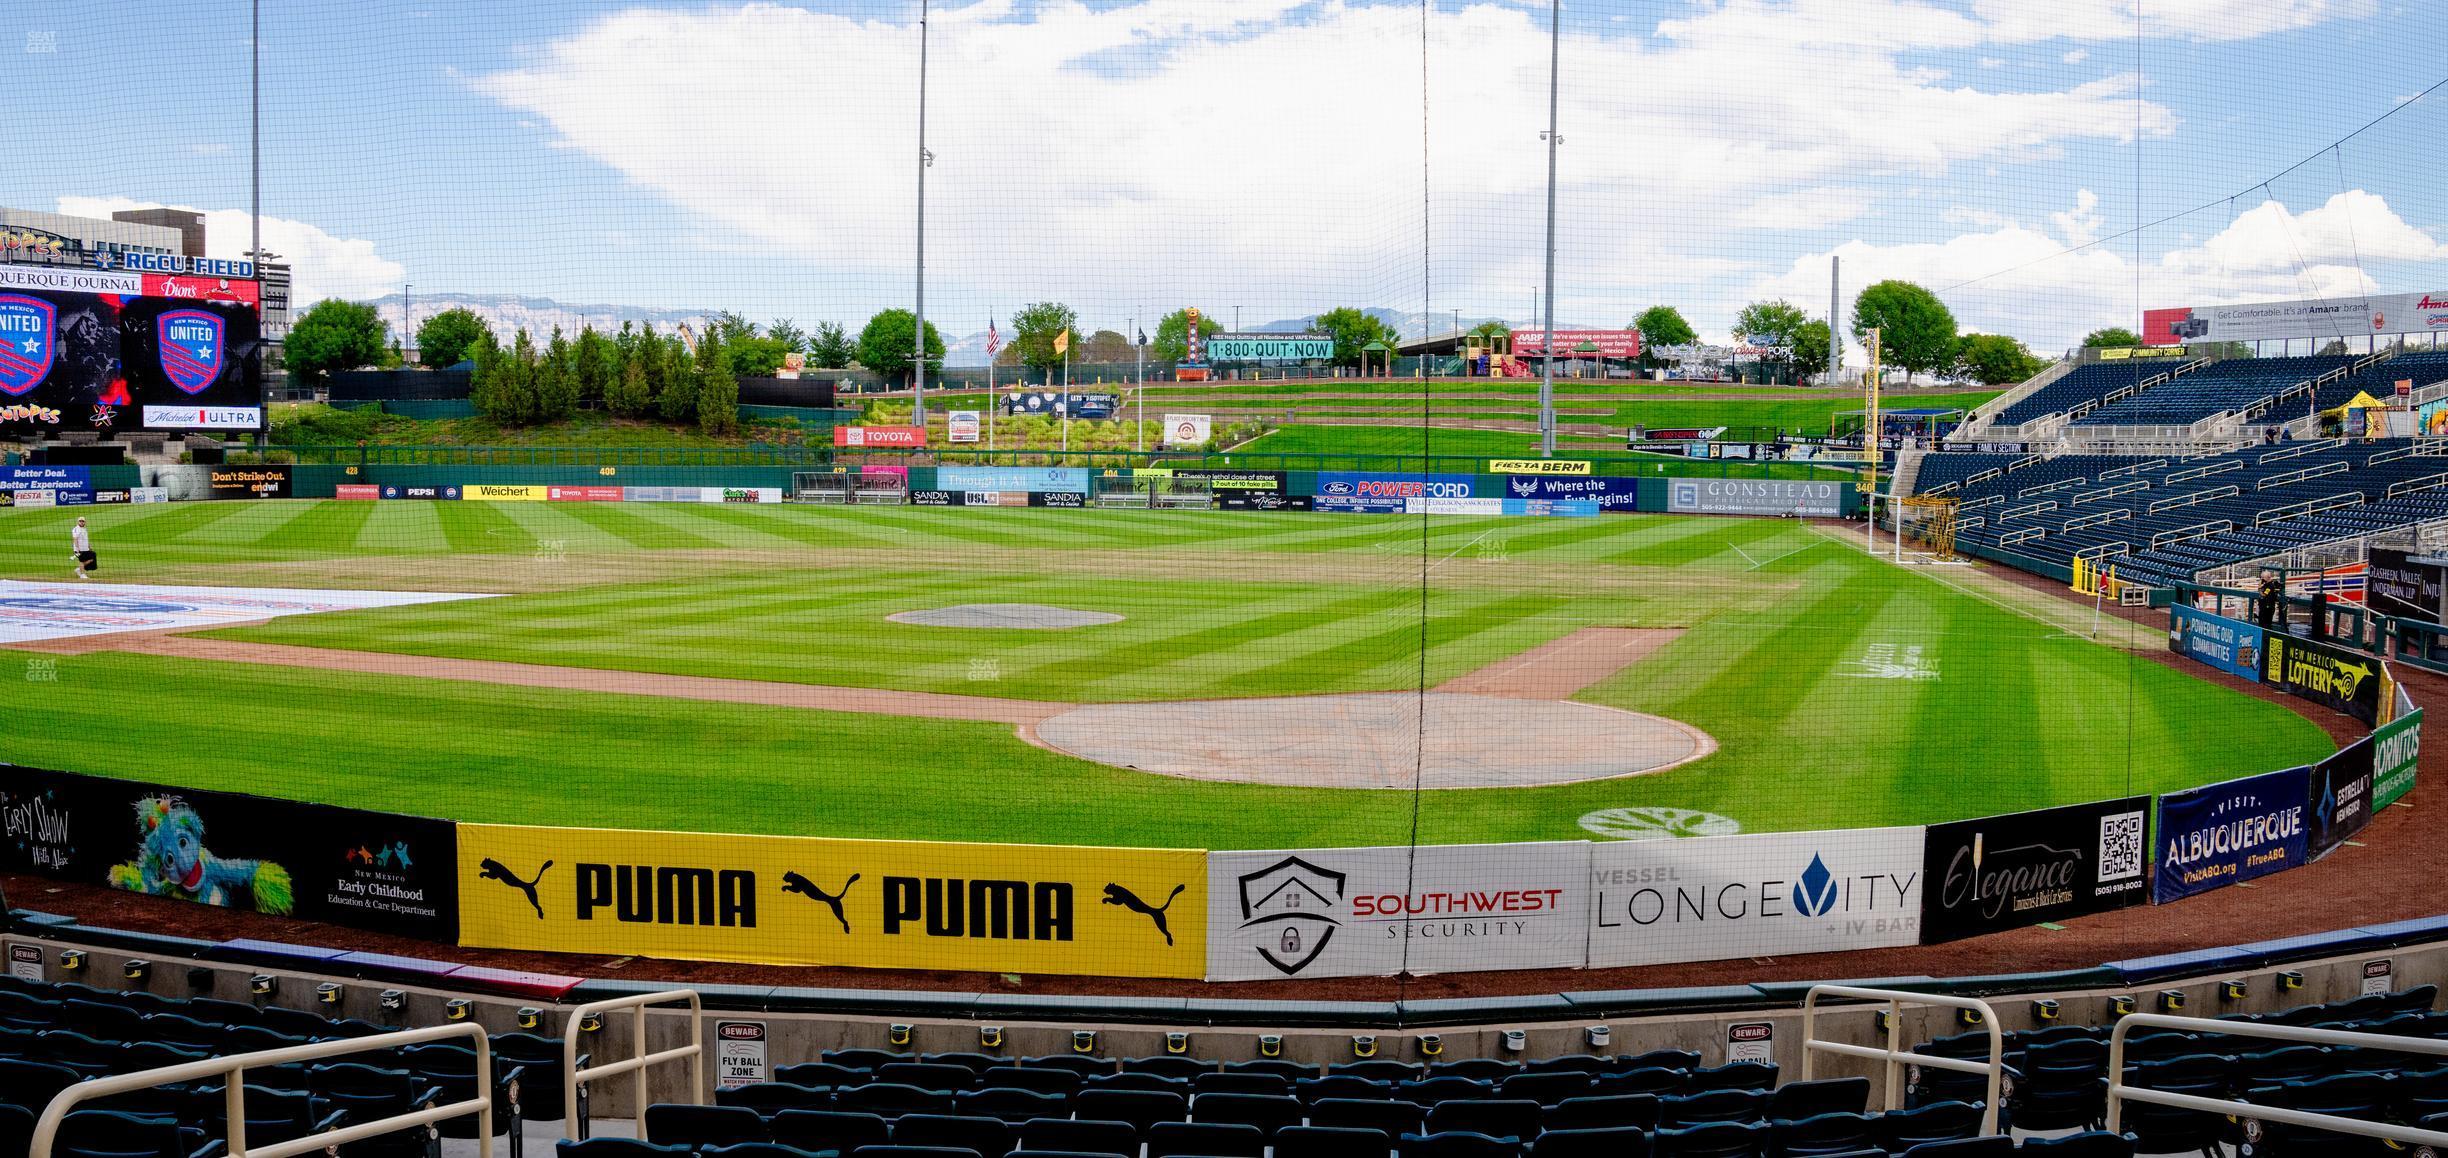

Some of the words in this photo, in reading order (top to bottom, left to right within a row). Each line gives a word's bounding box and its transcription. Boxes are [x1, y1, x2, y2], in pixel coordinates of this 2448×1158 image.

[124, 251, 185, 274] RGCU
[193, 256, 254, 278] FIELD
[72, 276, 140, 291] JOURNAL
[161, 276, 197, 298] Dion's
[2218, 311, 2231, 320] Get
[2232, 309, 2281, 319] Comfortable.
[170, 326, 213, 341] UNITED
[1516, 333, 1544, 341] AARP
[1569, 333, 1592, 342] working
[209, 412, 256, 423] ULTRA
[867, 432, 913, 441] TOYOTA
[1977, 443, 1997, 453] FAMILY
[1998, 443, 2021, 452] SECTION
[14, 469, 42, 478] Better
[45, 469, 67, 477] Deal.
[599, 467, 616, 476] 400
[1542, 463, 1586, 472] BERM
[212, 472, 237, 481] Don't
[238, 472, 265, 481] Strike
[266, 472, 285, 480] Out.
[949, 475, 995, 488] Through
[1013, 475, 1027, 487] All
[0, 481, 29, 489] Better
[251, 482, 279, 491] endwi
[480, 486, 529, 497] Weichert
[1328, 484, 1349, 493] Ford
[1545, 481, 1584, 493] Where
[1585, 479, 1606, 490] the
[1708, 481, 1832, 498] GONSTEAD
[1855, 482, 1873, 493] 340
[408, 488, 435, 496] PEPSI
[914, 491, 950, 500] SANDIA
[1044, 492, 1082, 502] SANDIA
[1588, 492, 1633, 507] Begins!
[2400, 569, 2421, 586] VALLES
[2405, 587, 2416, 600] LLP
[2191, 618, 2221, 640] POWERING
[2220, 626, 2234, 644] OUR
[2192, 636, 2230, 662] COMMUNITIES
[2289, 647, 2305, 662] NEW
[2306, 651, 2336, 670] MEXICO
[2288, 658, 2334, 695] LOTTERY
[2337, 776, 2364, 807] ESTRELLA
[2336, 806, 2346, 824] NEW
[2345, 798, 2360, 818] MEXICO
[3, 802, 33, 841] EARLY
[34, 795, 69, 845] SHOW
[2165, 806, 2303, 868] ALBUQUERQUE
[2183, 863, 2237, 885] VisitABQ.org
[2247, 848, 2285, 868] #TrueABQ
[355, 869, 373, 879] NEW
[375, 871, 406, 882] MEXICO
[1595, 866, 1681, 886] VESSEL
[338, 878, 366, 896] Early
[368, 882, 424, 901] Childhood
[576, 862, 757, 928] PUMA
[1598, 851, 1917, 928] LONGEVITY
[2095, 885, 2112, 897] (505)
[2112, 880, 2143, 893] 918-8002
[327, 893, 364, 908] Education
[364, 899, 372, 908] &
[372, 899, 390, 911] Care
[391, 902, 436, 917] Department
[883, 875, 1074, 942] PUMA
[1352, 889, 1563, 916] SOUTHWEST
[1387, 921, 1528, 939] SECURITY
[1845, 921, 1866, 936] IV
[1875, 916, 1918, 933] BAR
[15, 950, 39, 960] BEWARE
[2367, 964, 2388, 974] BEWARE
[725, 1027, 758, 1036] BEWARE
[1735, 1028, 1766, 1038] BEWARE
[722, 1056, 738, 1066] FLY
[740, 1057, 763, 1067] BALL
[731, 1067, 754, 1077] ZONE
